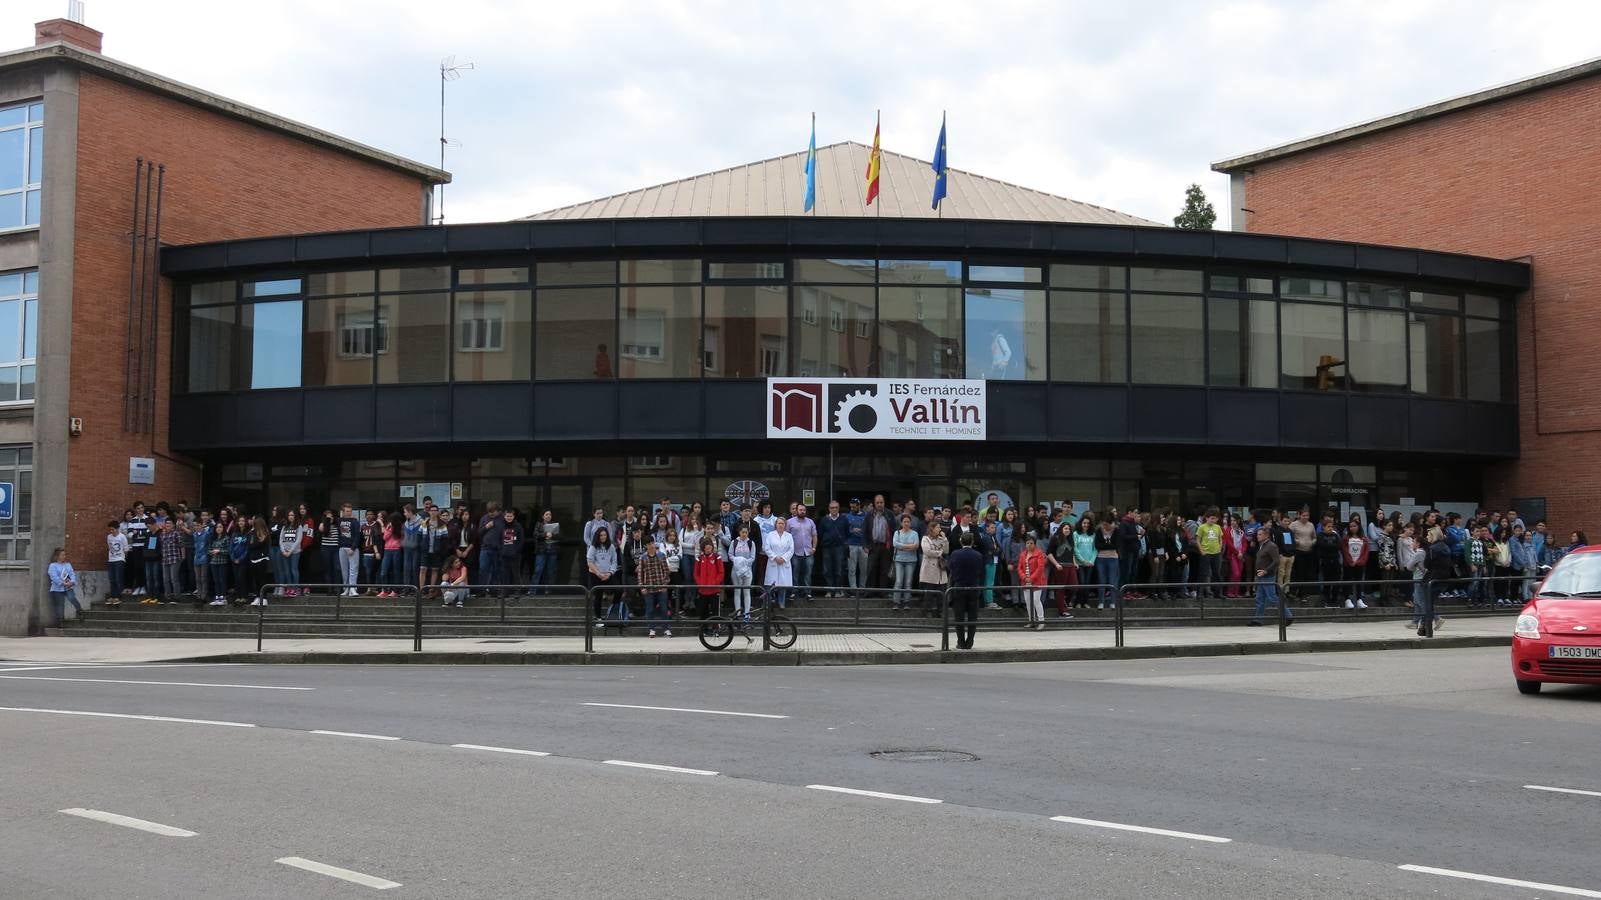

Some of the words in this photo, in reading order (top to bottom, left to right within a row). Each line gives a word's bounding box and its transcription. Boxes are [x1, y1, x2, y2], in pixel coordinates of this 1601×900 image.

[889, 384, 909, 394] IES
[914, 384, 980, 395] Fernández
[889, 398, 980, 423] Vallín
[890, 427, 927, 435] TECHNICI
[1558, 647, 1581, 656] 1503
